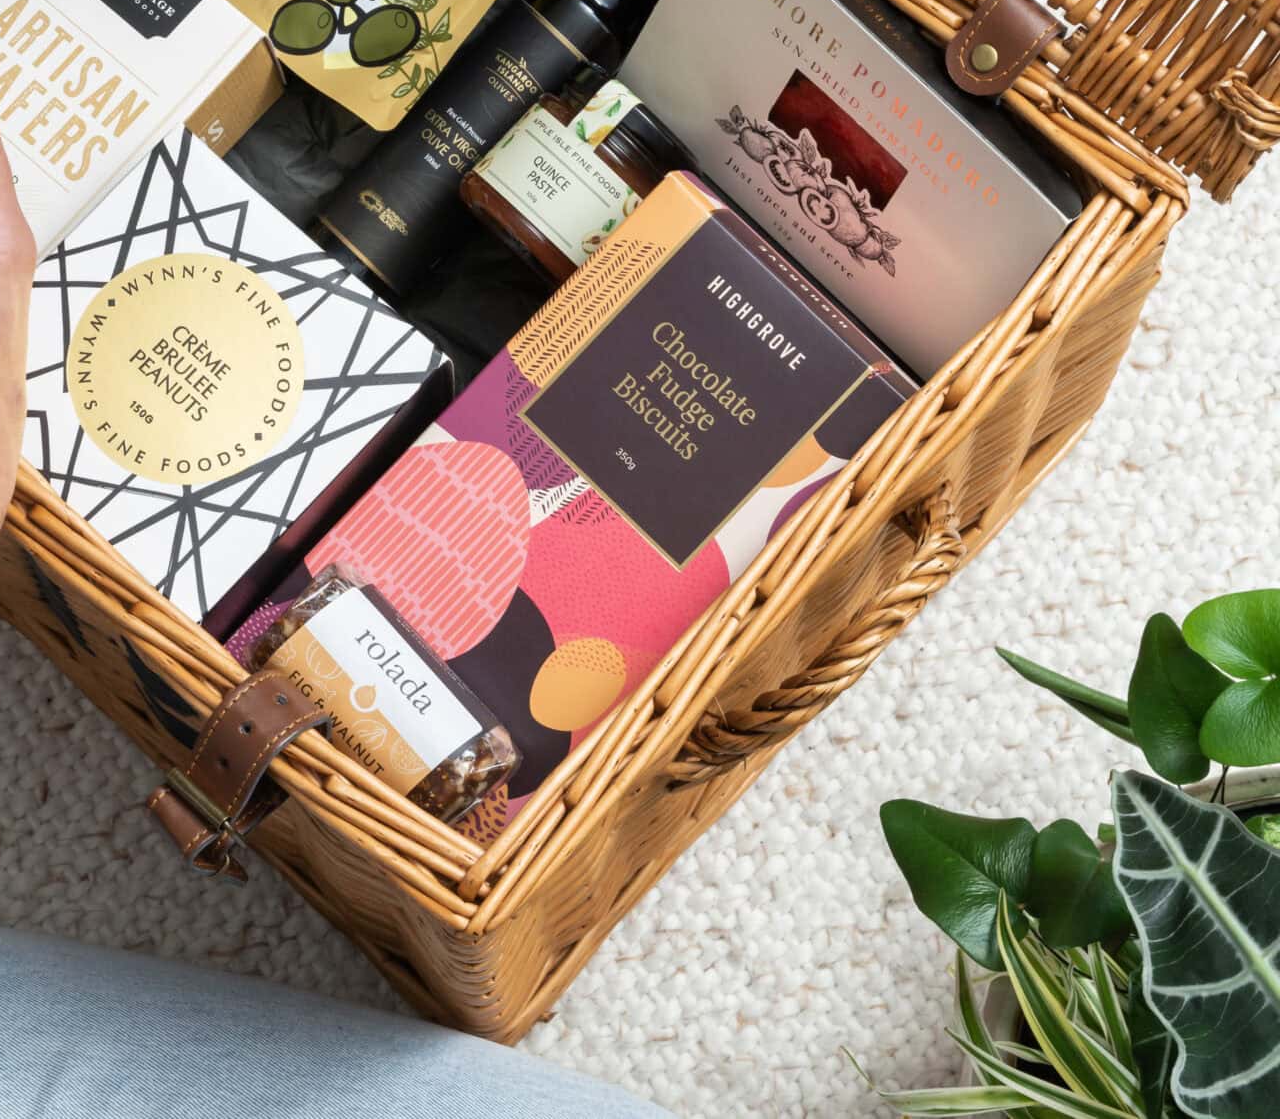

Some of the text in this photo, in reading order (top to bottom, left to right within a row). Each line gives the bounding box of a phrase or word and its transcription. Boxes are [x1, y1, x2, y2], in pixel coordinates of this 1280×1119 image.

[488, 76, 517, 103] OLIVES
[494, 53, 537, 94] KANGAROO
[497, 65, 526, 93] ISLAND
[771, 26, 861, 116] SUN-DRIED
[422, 128, 467, 174] OLIVE OIL
[424, 108, 453, 138] EXTRA
[534, 118, 621, 200] APPLE ISLE FINE FOODS
[851, 61, 1001, 209] POMADORO
[527, 170, 558, 201] PASTE
[533, 155, 571, 193] QUINCE
[756, 186, 788, 219] open
[792, 218, 817, 243] and
[819, 245, 854, 280] serve
[121, 265, 292, 428] WYNN'S FINE FOODS
[172, 325, 232, 381] CRÈME
[707, 275, 806, 371] HIGHGROVE
[78, 313, 247, 474] WYNN'S FINE FOODS
[129, 348, 209, 422] PEANUTS
[152, 338, 219, 400] BRULEE
[646, 360, 716, 432] Fudge
[652, 321, 757, 426] Chocolate
[128, 399, 155, 425] 150G
[612, 372, 700, 461] Biscuits
[615, 447, 638, 471] 350g
[354, 628, 433, 715] rolada
[288, 669, 314, 698] FIG
[328, 710, 385, 776] WALNUT
